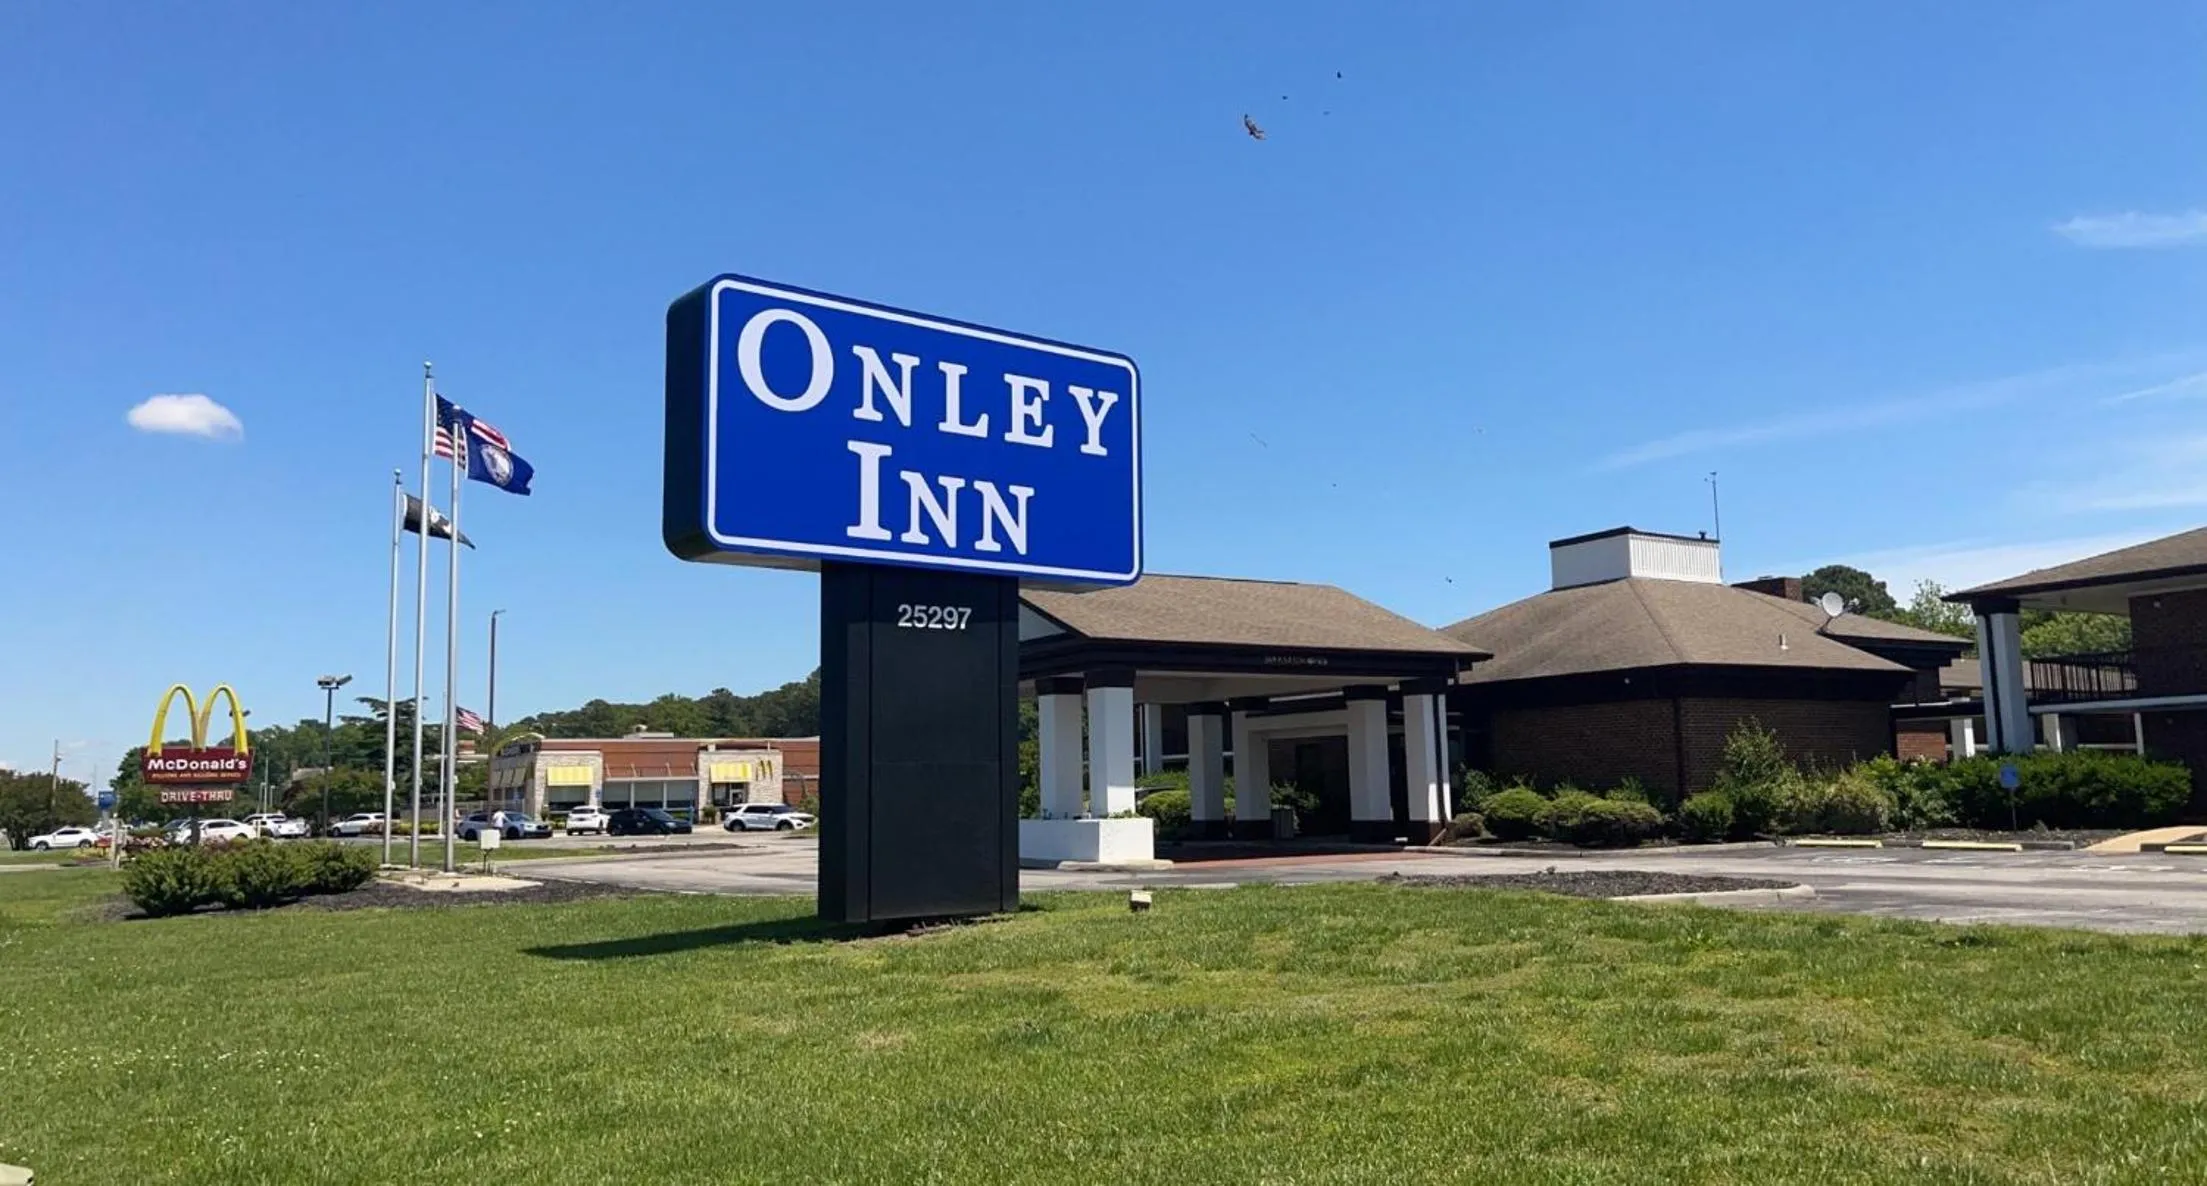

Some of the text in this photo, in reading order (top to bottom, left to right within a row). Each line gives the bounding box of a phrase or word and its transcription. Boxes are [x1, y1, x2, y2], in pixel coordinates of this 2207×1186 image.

[737, 308, 1119, 456] ONLEY
[846, 440, 1035, 555] INN
[897, 604, 972, 630] 25297
[147, 758, 247, 770] McDonald's
[160, 789, 233, 803] DRIVE-THRU
